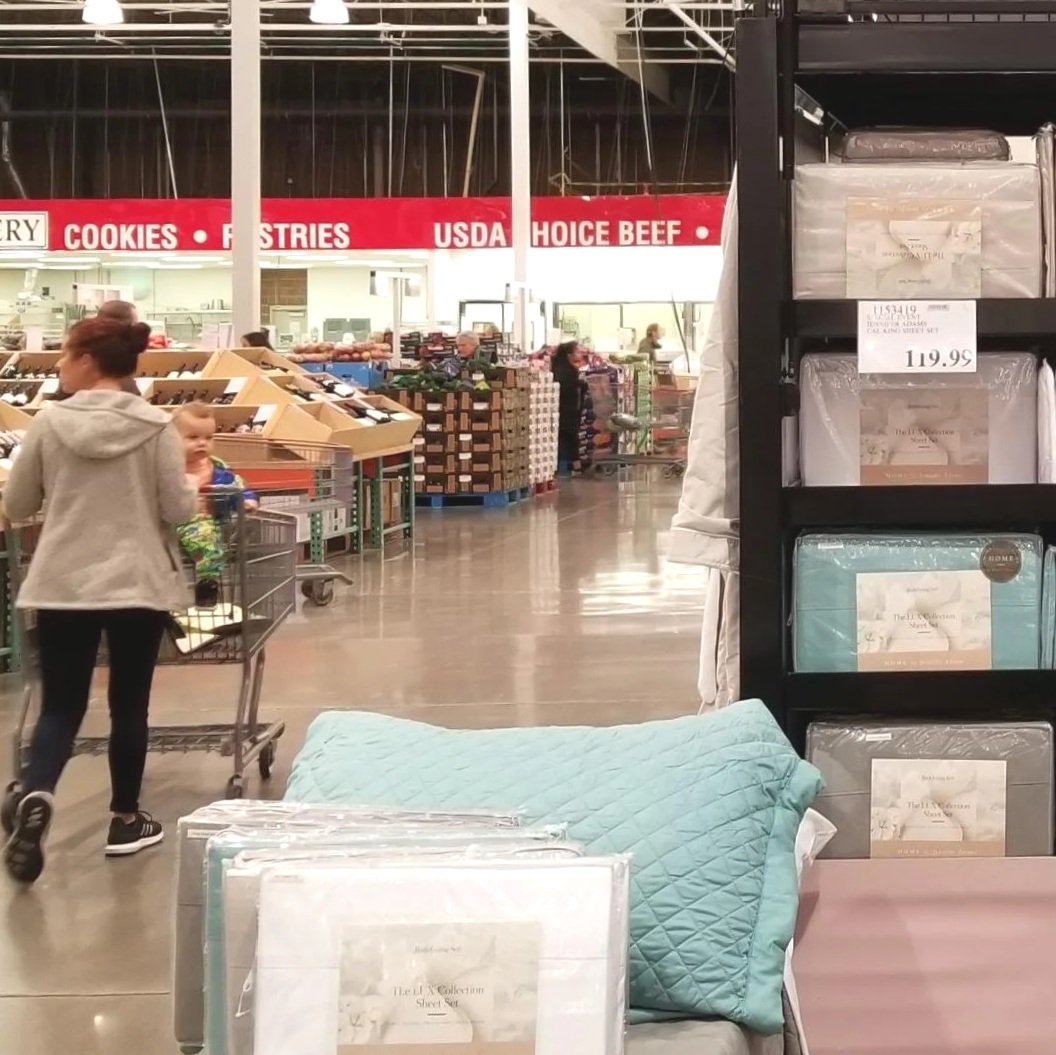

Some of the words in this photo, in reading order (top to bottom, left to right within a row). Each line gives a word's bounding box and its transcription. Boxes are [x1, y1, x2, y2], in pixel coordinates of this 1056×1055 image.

[64, 223, 178, 250] COOKIES
[222, 222, 351, 249] PSTRIES
[434, 221, 508, 248] USDA
[531, 220, 610, 246] HOICE
[618, 220, 682, 245] BEEF
[906, 349, 972, 368] 119.99
